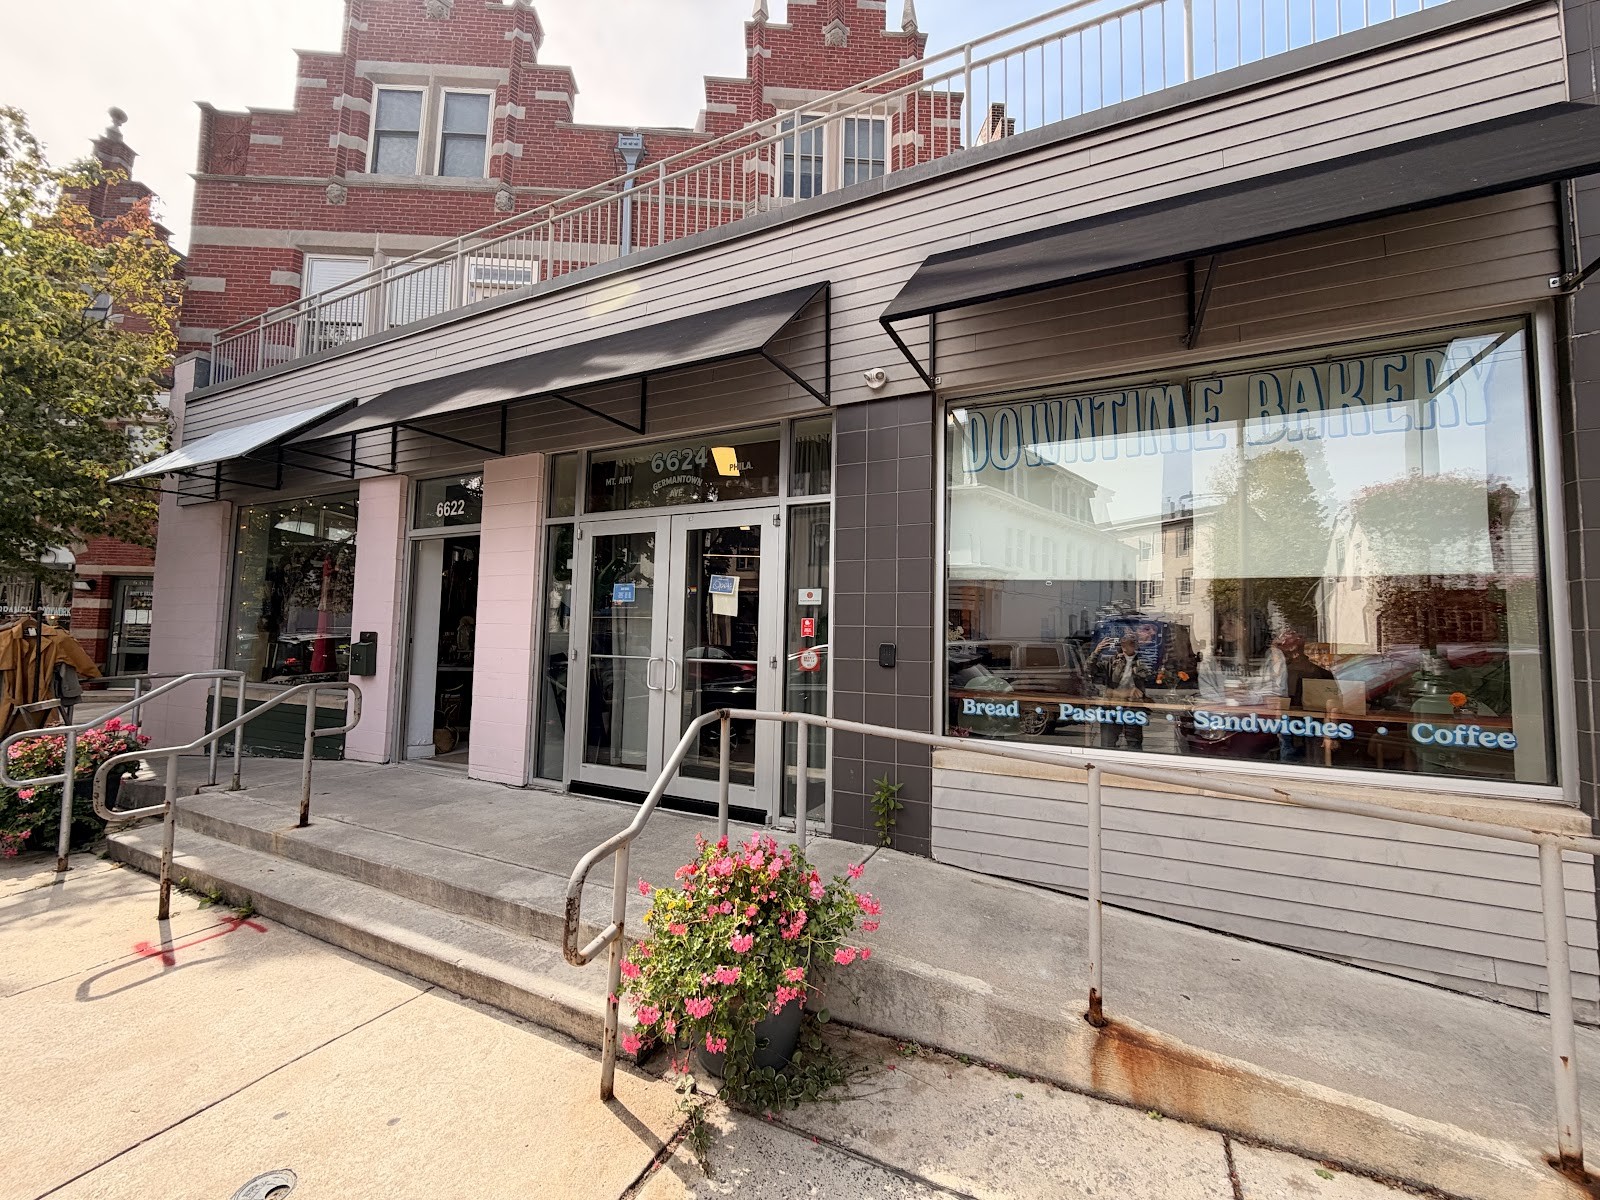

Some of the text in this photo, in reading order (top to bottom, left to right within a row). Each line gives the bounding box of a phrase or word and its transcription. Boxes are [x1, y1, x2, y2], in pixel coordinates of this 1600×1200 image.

[962, 345, 1496, 473] DOWNTIME BAKERY
[651, 446, 708, 473] 6624
[729, 461, 753, 472] PHILA.
[605, 476, 633, 487] MT. AIRY
[652, 474, 703, 491] GERMANTOWN
[669, 488, 685, 498] AVE.
[436, 499, 465, 518] 6622
[962, 698, 1020, 718] Bread
[1059, 703, 1150, 726] Pastries
[1193, 710, 1355, 740] Sandwiches
[1411, 722, 1518, 750] Coffee
